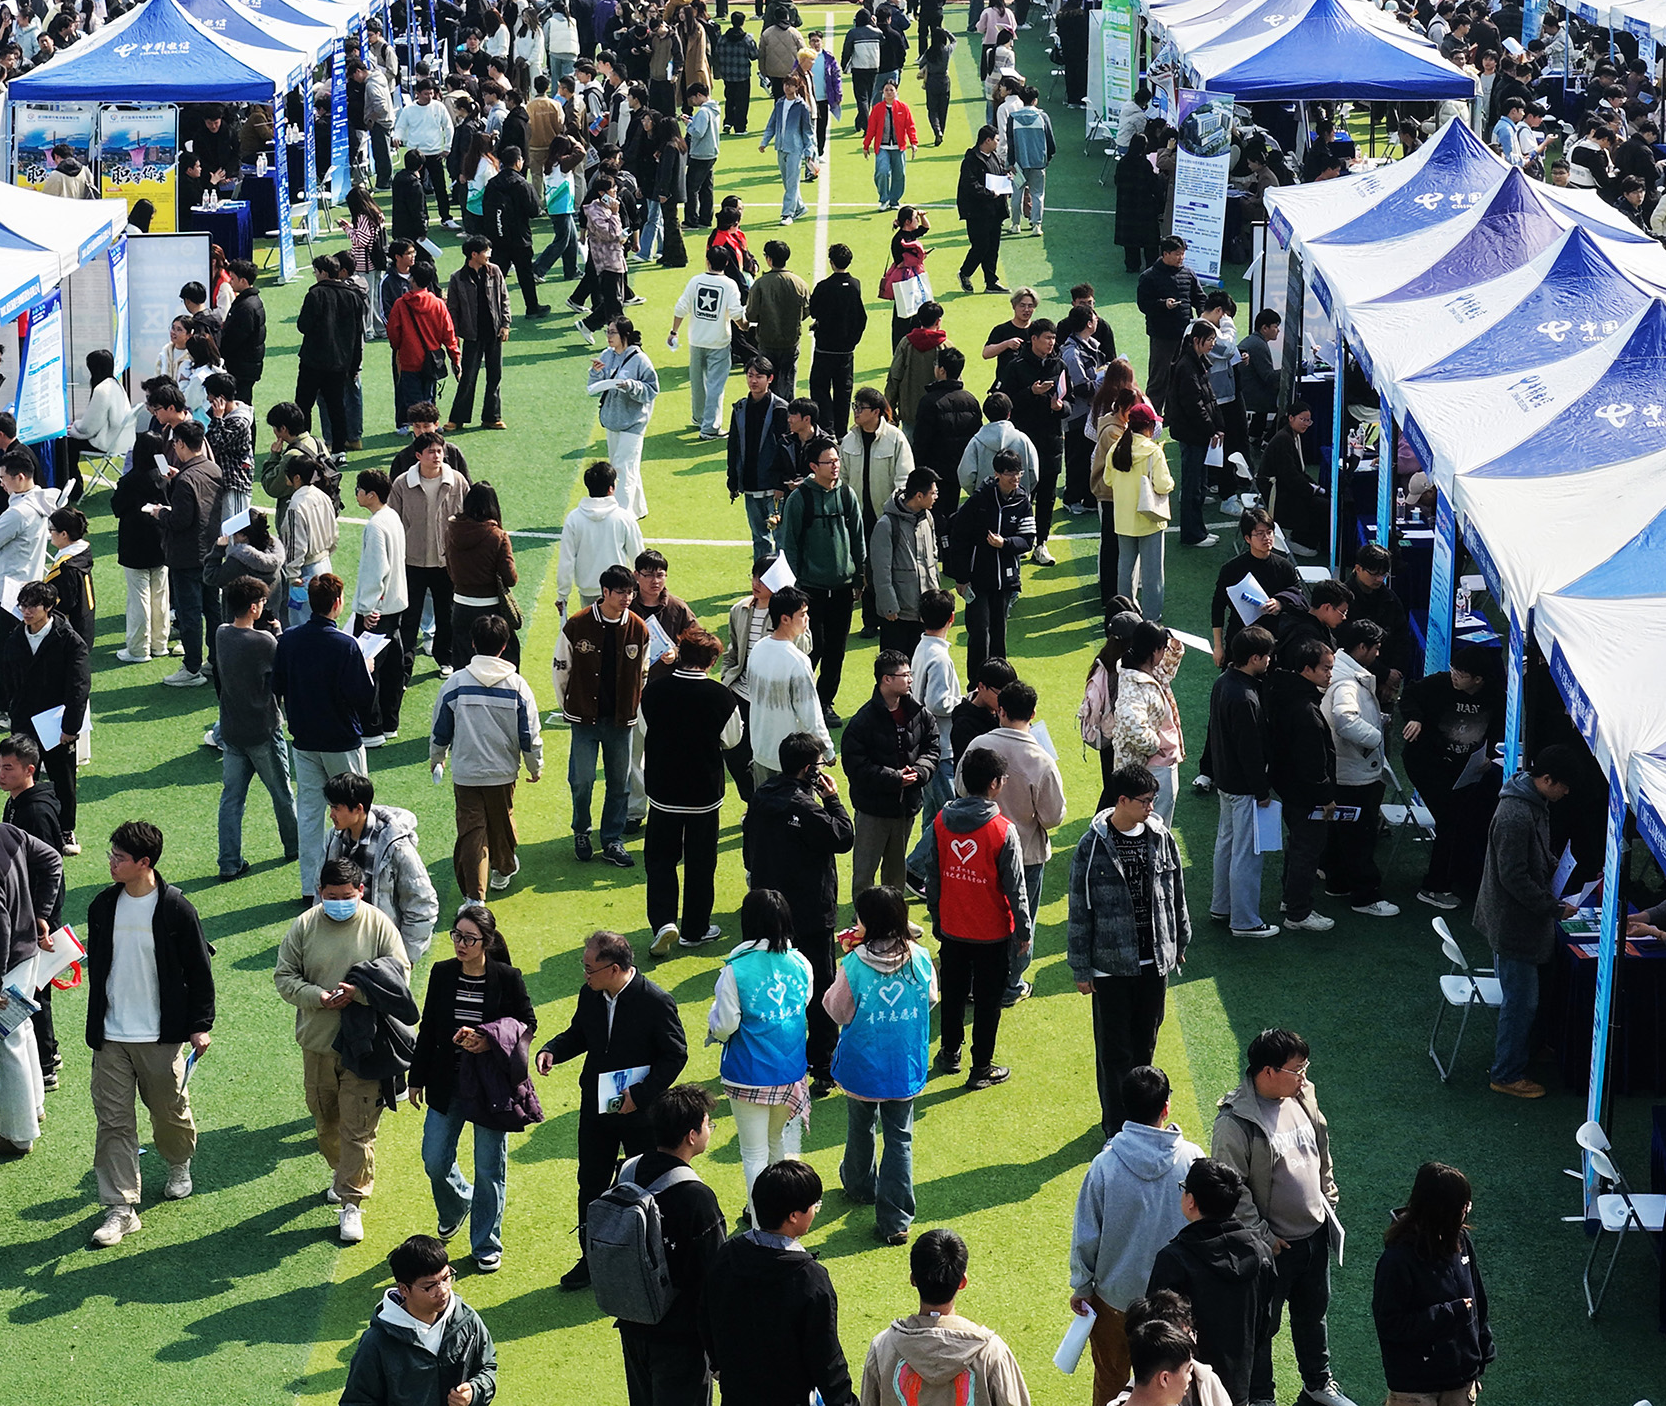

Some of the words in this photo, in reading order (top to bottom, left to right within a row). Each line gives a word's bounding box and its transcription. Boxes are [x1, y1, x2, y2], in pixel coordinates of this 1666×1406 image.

[141, 40, 190, 53] 中国电信
[866, 1007, 919, 1025] 青年志愿者
